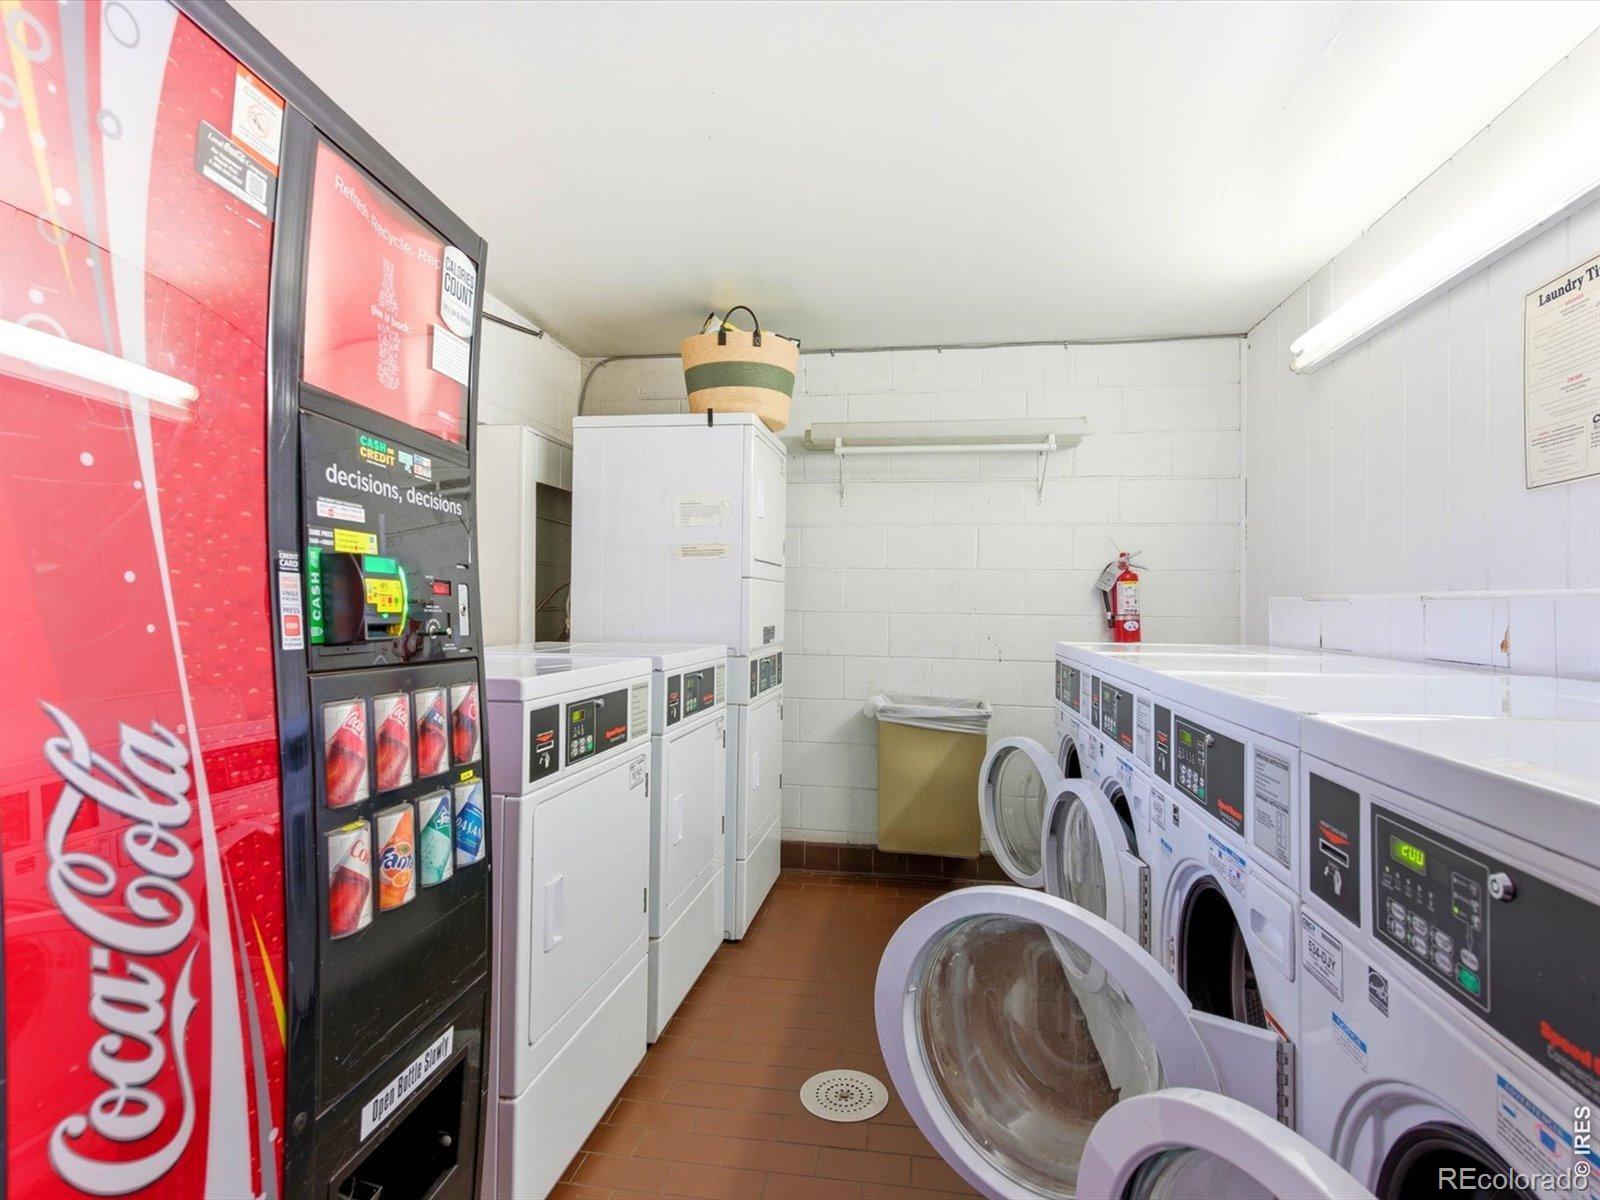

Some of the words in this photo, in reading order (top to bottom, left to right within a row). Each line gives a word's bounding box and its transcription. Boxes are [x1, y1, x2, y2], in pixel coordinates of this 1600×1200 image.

[444, 272, 474, 309] COUNT
[445, 256, 475, 290] CALORIES
[1538, 275, 1584, 307] Laundry
[1585, 264, 1600, 282] Ti
[359, 434, 387, 454] CASH
[359, 446, 396, 468] CREDIT
[325, 462, 402, 505] decisions,
[406, 484, 462, 516] decisions
[280, 559, 299, 568] CARD
[311, 572, 322, 622] CASH
[37, 698, 200, 1196] Coca-Cola
[1307, 940, 1336, 971] 534-DJY
[371, 1088, 395, 1122] Open
[397, 1061, 422, 1098] Bottle
[424, 1036, 449, 1073] Slowly
